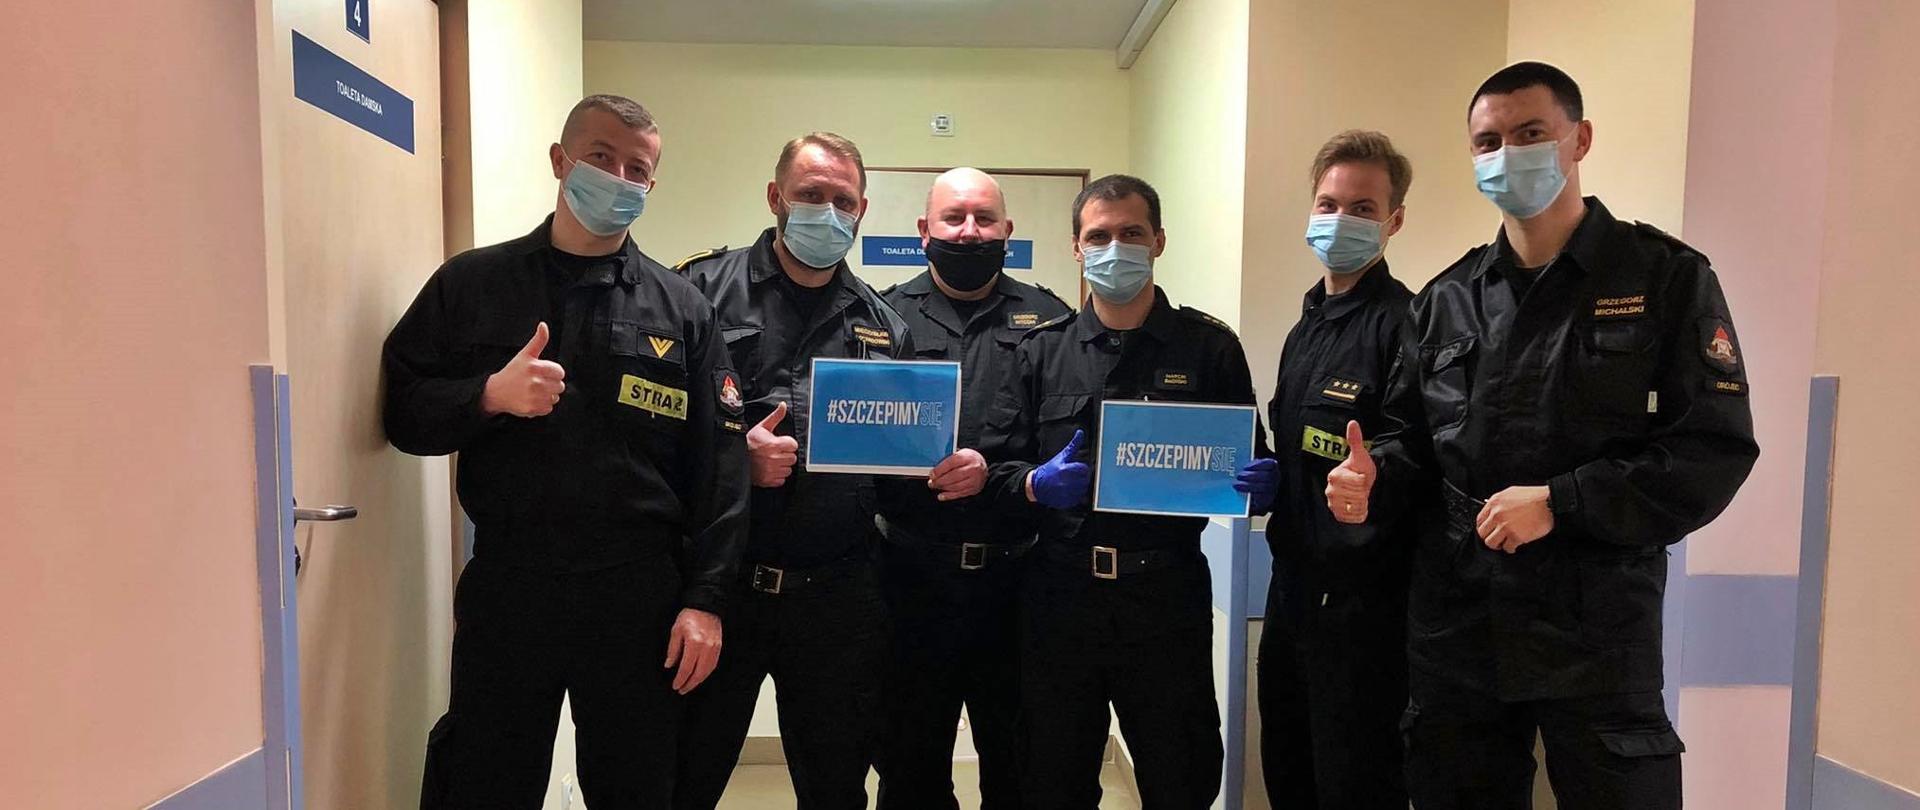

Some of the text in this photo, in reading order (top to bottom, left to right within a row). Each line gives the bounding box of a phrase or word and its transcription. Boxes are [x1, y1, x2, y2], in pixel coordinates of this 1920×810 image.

[353, 0, 361, 27] 4
[336, 80, 361, 105] TOALETA
[882, 247, 915, 255] TOALETA
[1596, 295, 1645, 306] GRZEGORZ
[1594, 306, 1645, 316] MICHALSKI
[1311, 435, 1351, 457] STR
